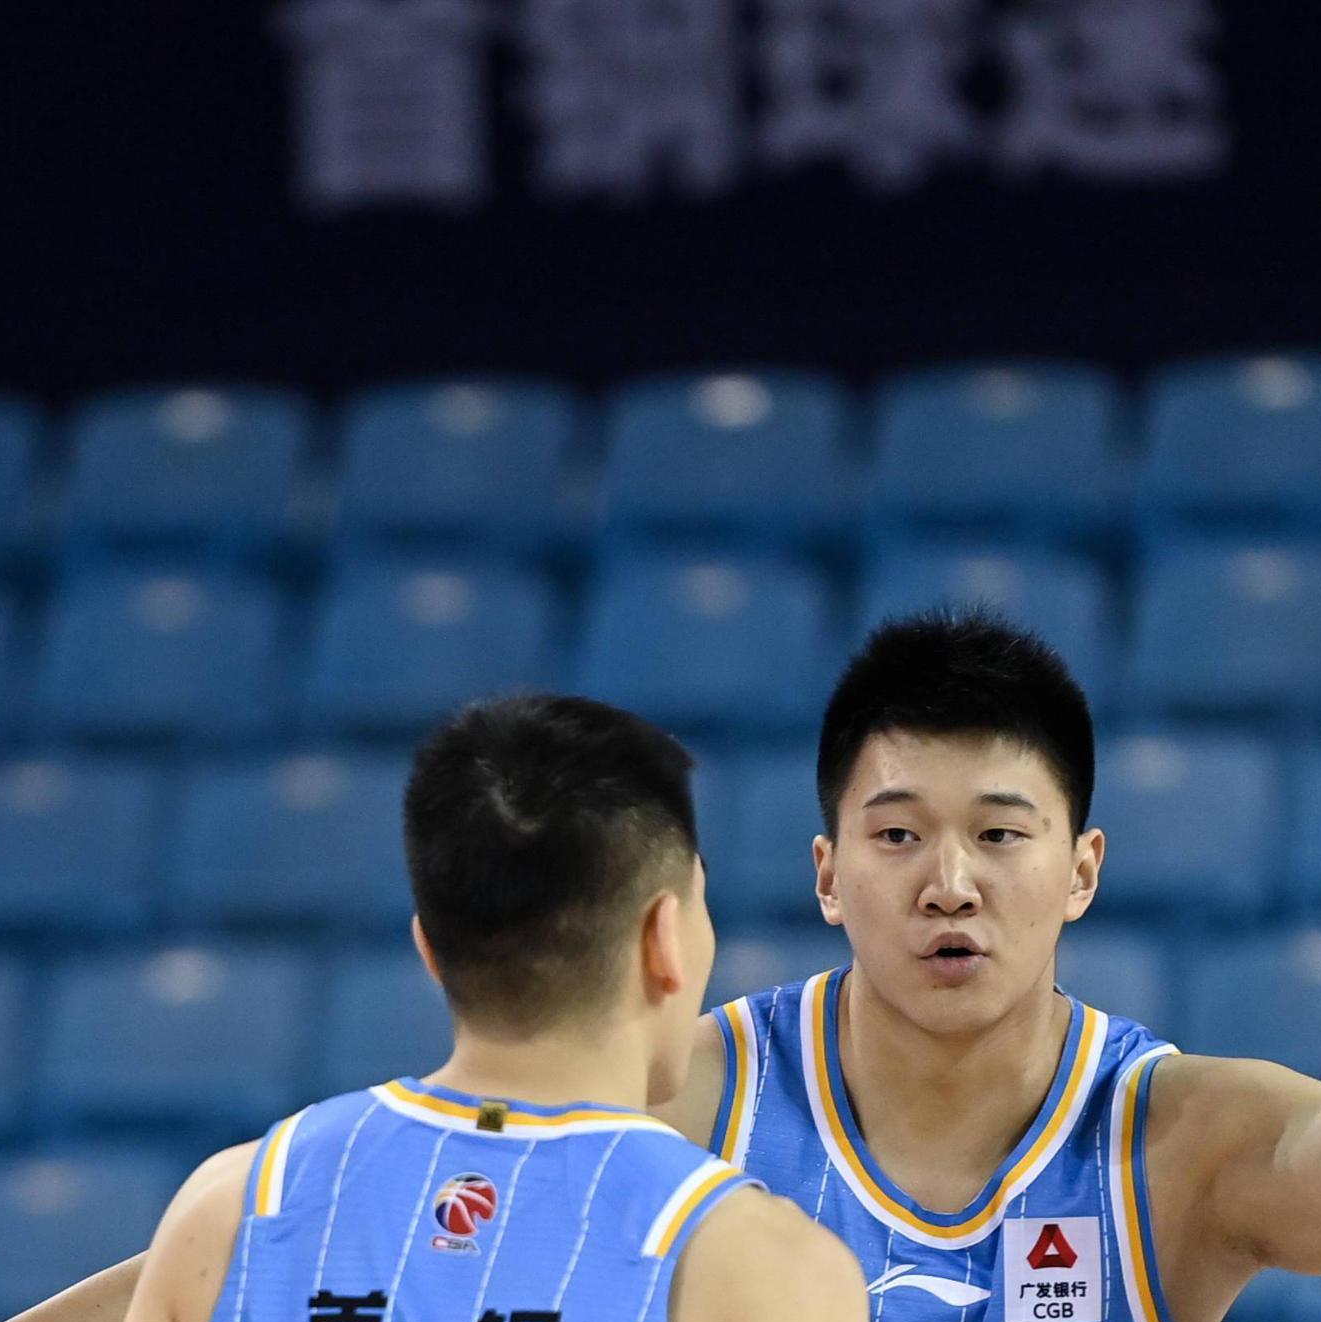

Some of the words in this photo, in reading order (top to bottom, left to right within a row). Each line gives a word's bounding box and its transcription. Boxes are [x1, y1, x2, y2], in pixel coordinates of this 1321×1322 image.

[1019, 1281, 1087, 1299] 广发银行
[1033, 1302, 1074, 1319] CGB
